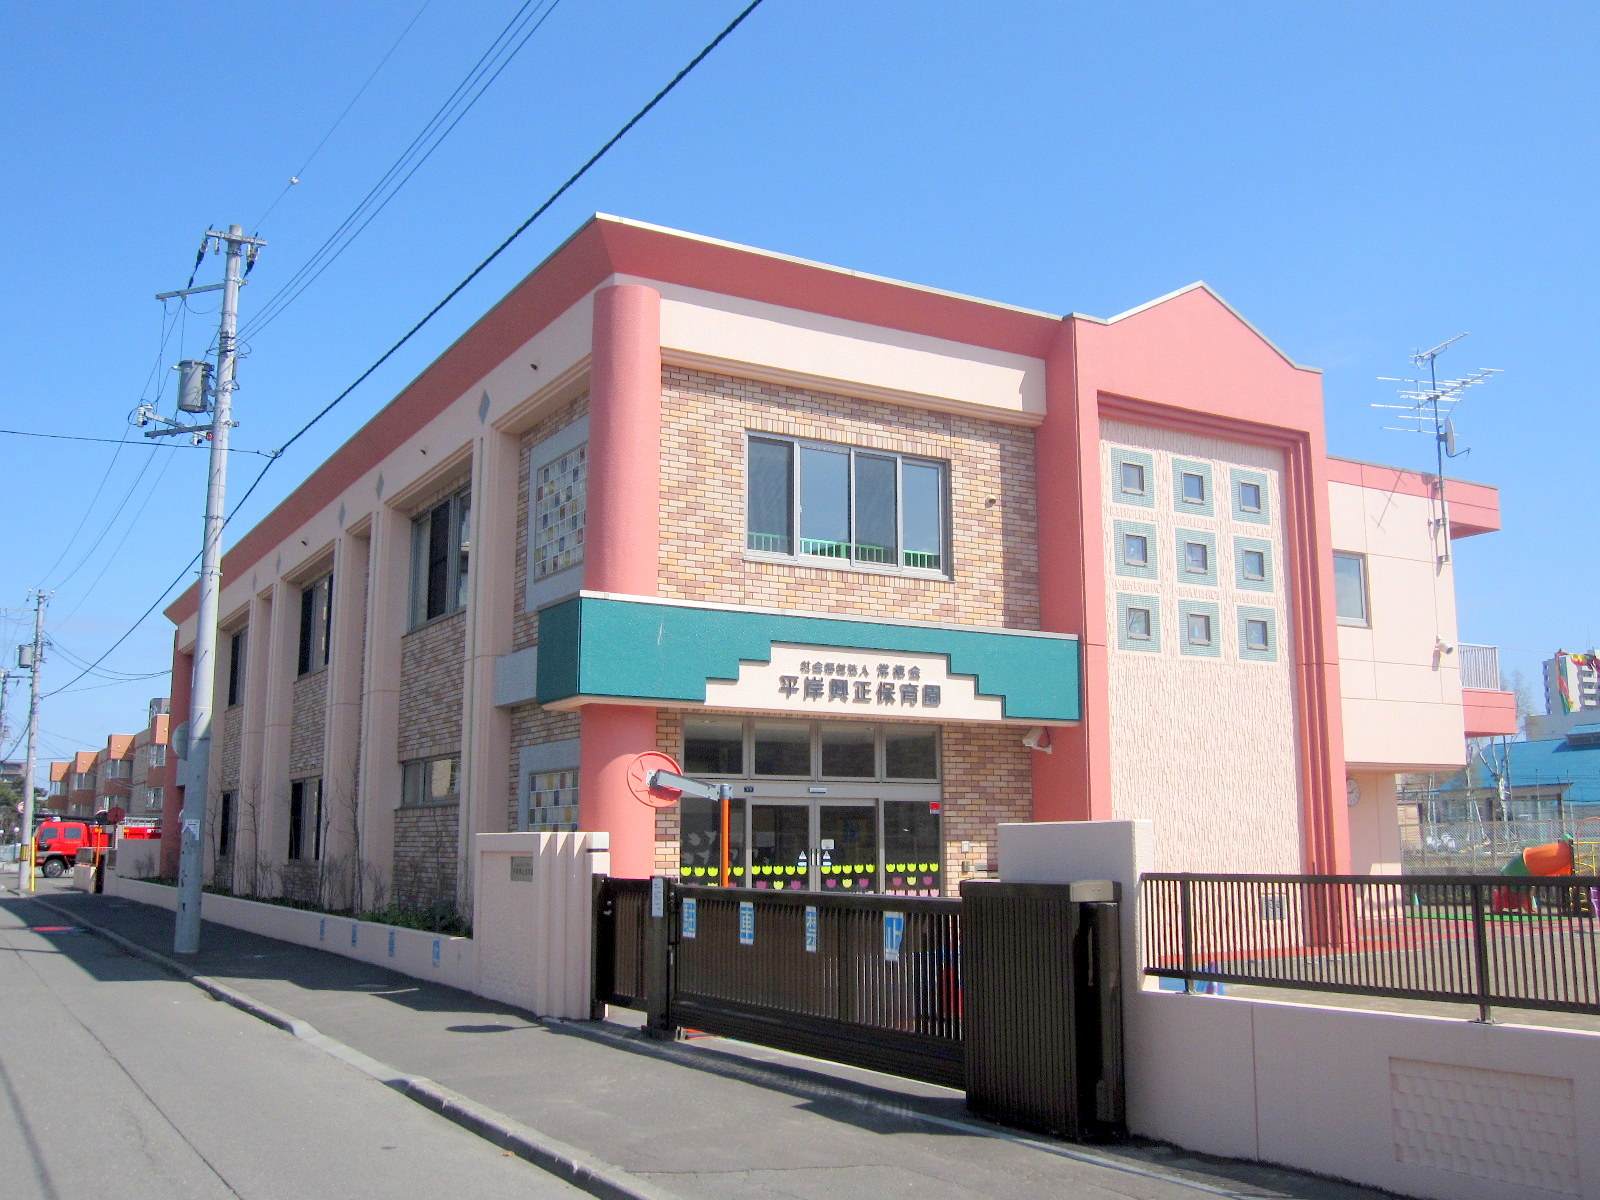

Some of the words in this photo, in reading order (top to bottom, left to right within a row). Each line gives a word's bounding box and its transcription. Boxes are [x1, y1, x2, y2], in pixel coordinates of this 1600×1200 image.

[800, 660, 869, 678] 社会福祉法人
[778, 675, 941, 707] 平岸興正保育園
